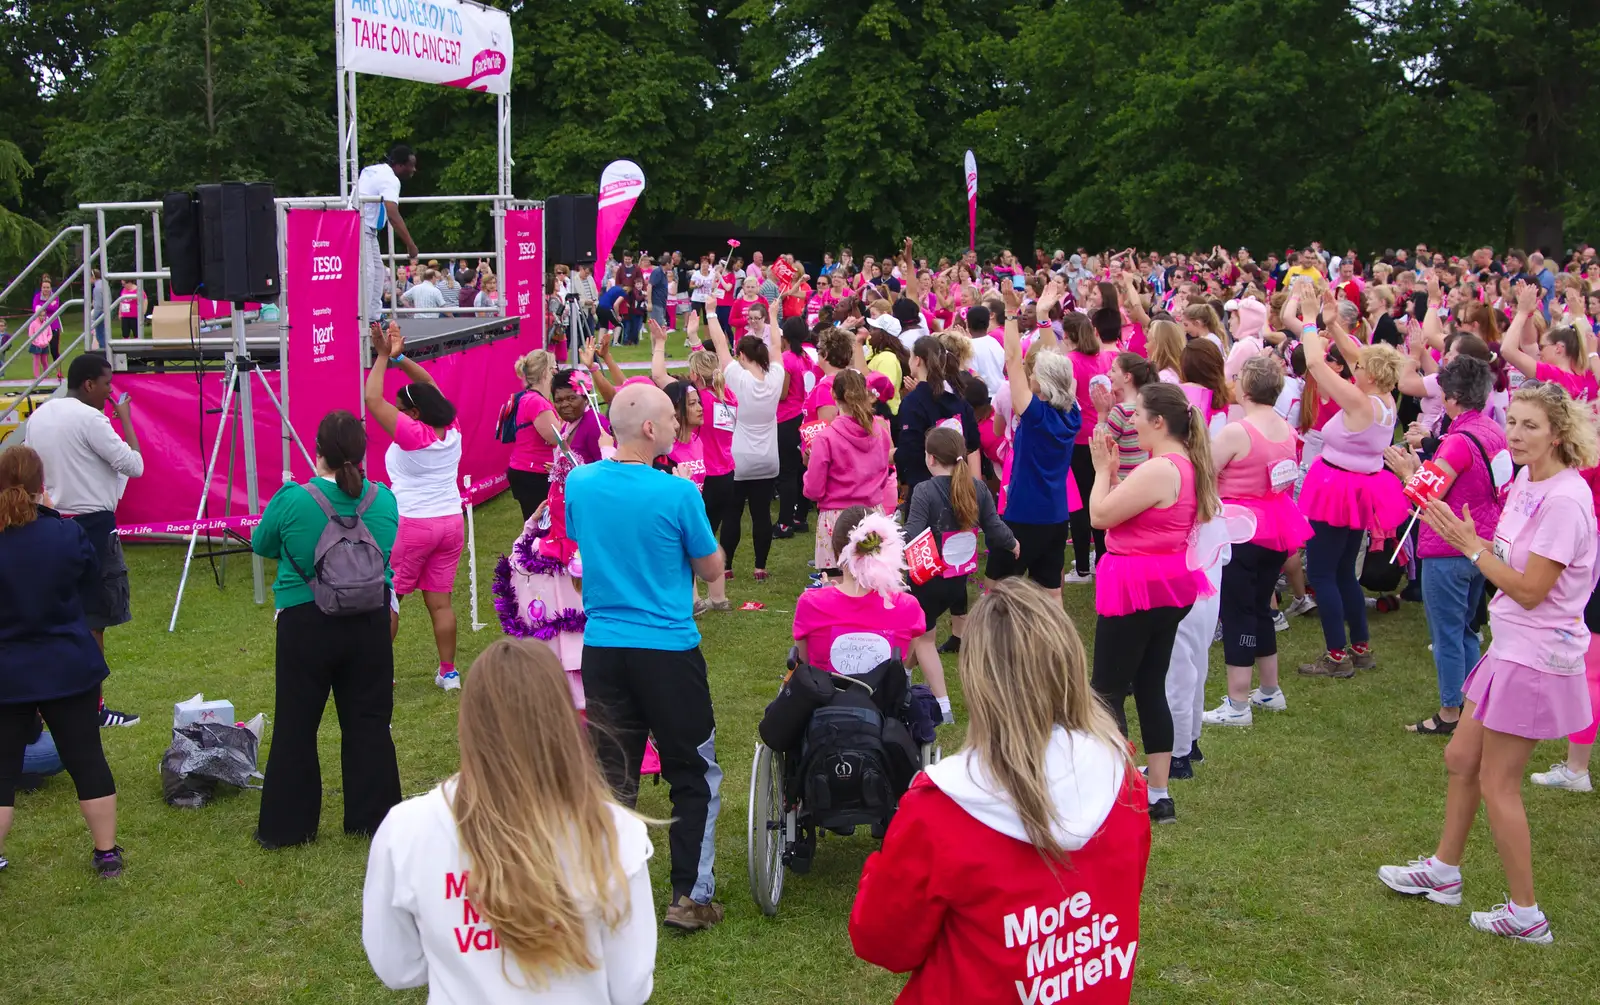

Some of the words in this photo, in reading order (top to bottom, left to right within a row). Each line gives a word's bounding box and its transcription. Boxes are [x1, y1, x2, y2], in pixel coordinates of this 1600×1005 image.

[408, 0, 446, 31] READY
[447, 8, 463, 36] TO
[351, 17, 388, 52] TAKE
[391, 26, 410, 56] ON
[413, 31, 461, 66] CANCER?
[518, 242, 536, 254] TESCO
[313, 256, 342, 273] TESCO
[312, 322, 335, 344] heart
[800, 421, 826, 438] heart
[1414, 466, 1445, 493] eart
[134, 526, 152, 534] Life
[167, 524, 190, 532] Race
[192, 522, 207, 530] for
[209, 520, 227, 529] Life
[918, 535, 942, 576] heart
[840, 660, 860, 673] Phil
[1004, 891, 1091, 948] More
[1026, 913, 1119, 978] Music
[1015, 941, 1137, 1005] Variety
